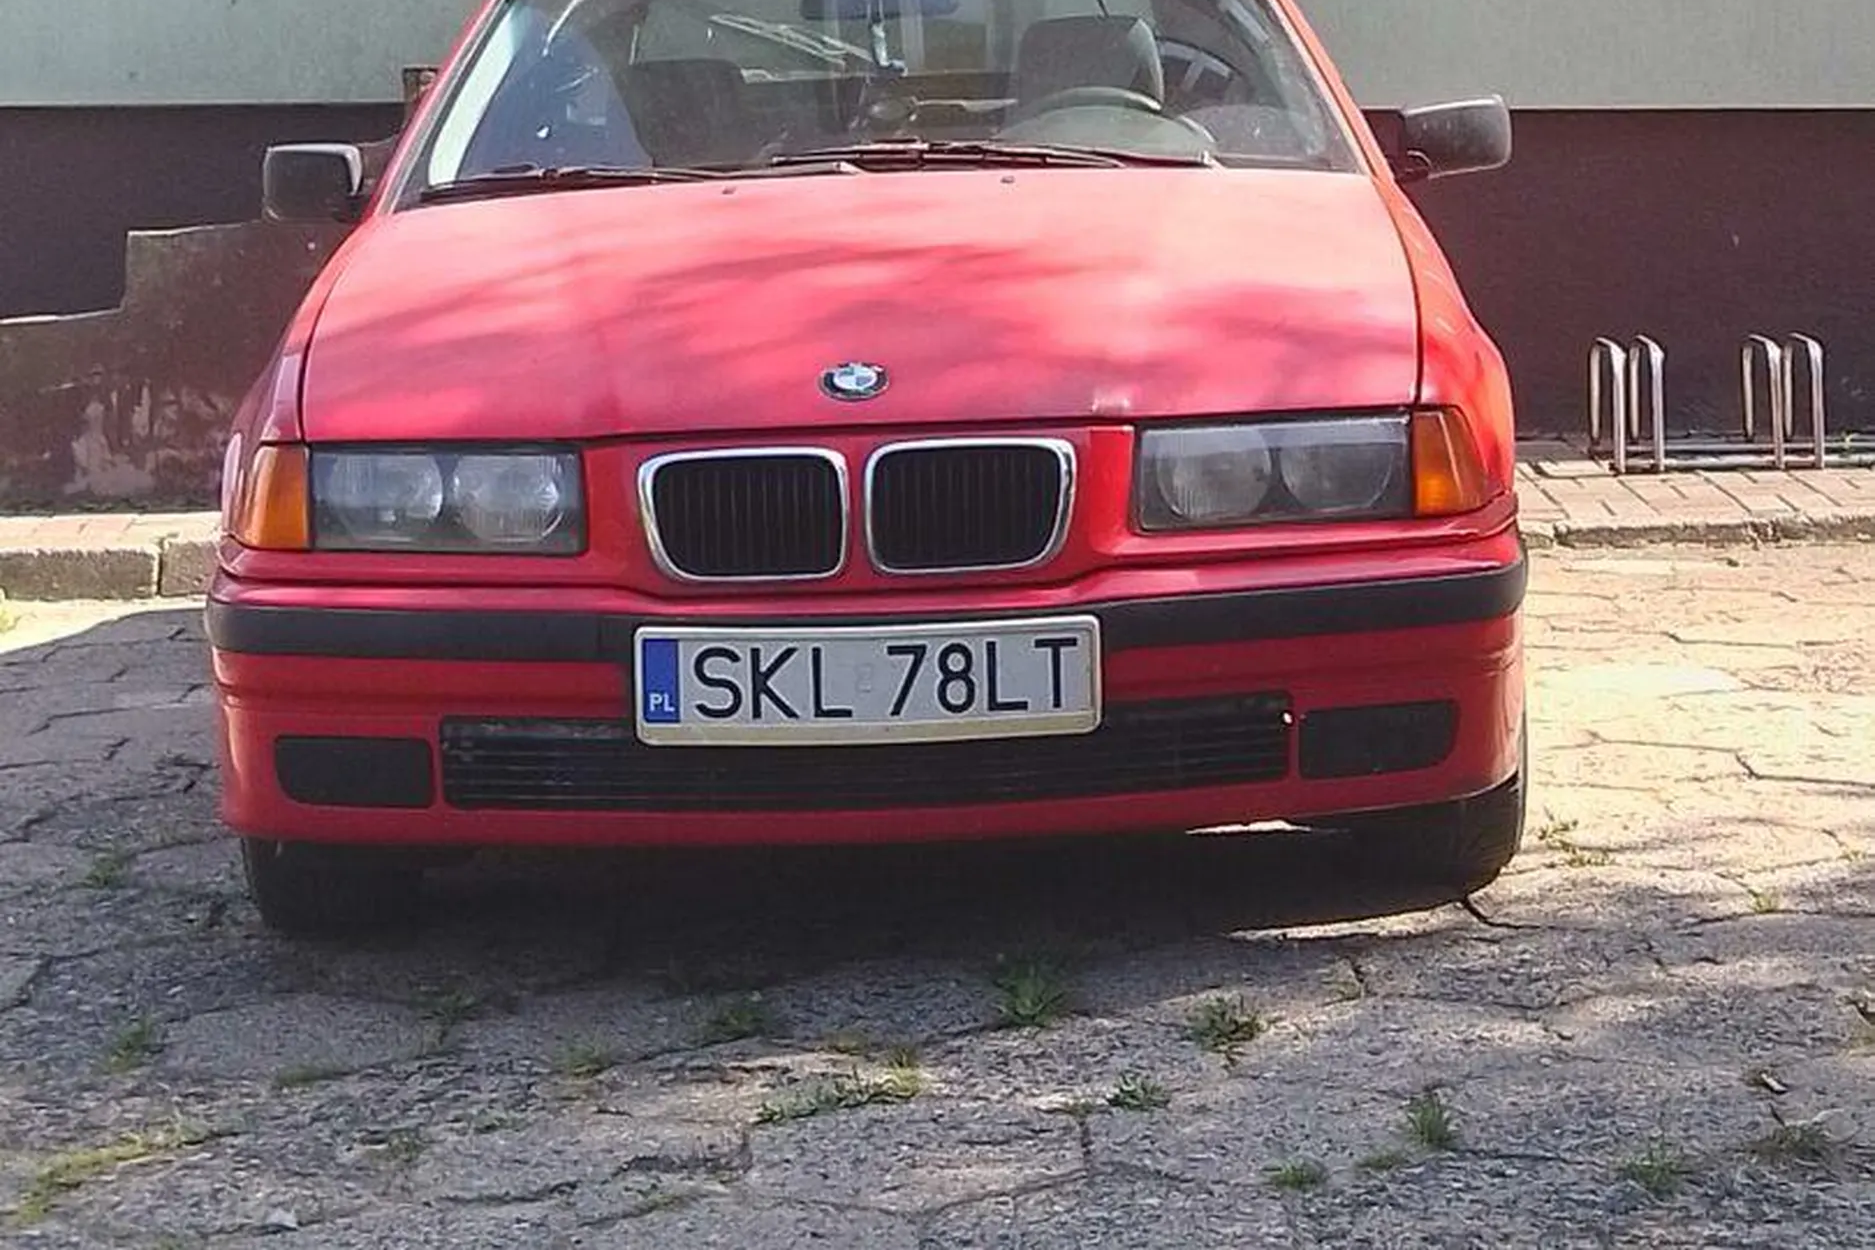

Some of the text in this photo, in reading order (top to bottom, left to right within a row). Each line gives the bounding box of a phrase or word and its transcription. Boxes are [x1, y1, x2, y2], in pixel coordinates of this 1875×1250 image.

[693, 637, 1078, 719] SKL 78LT
[649, 695, 675, 713] PL
